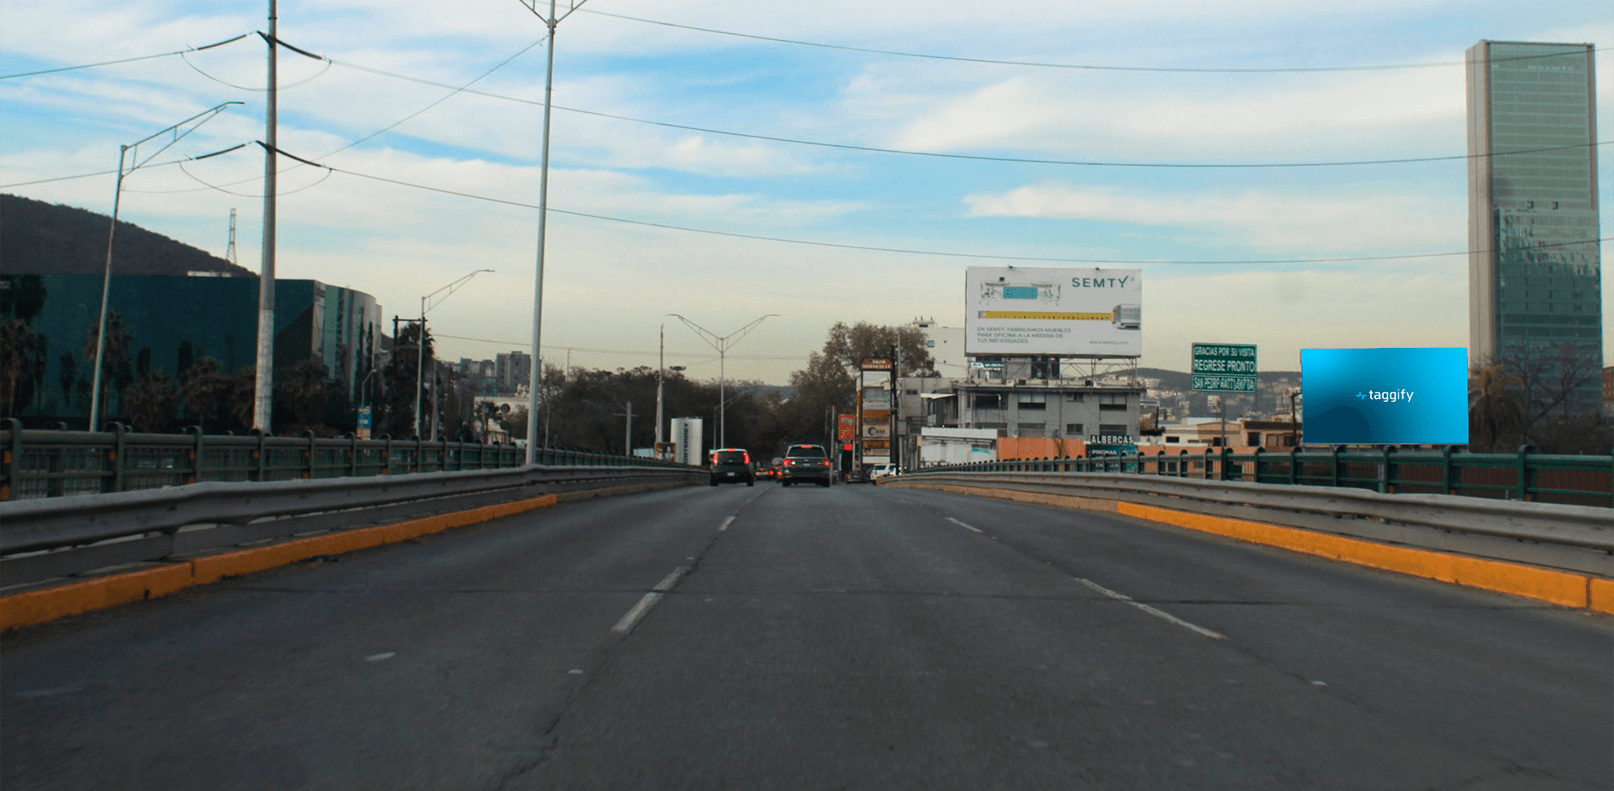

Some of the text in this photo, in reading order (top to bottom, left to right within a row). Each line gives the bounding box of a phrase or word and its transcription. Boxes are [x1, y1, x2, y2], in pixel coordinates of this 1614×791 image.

[1072, 276, 1128, 288] SEMTY
[1194, 346, 1218, 356] GRACIAS
[1219, 347, 1230, 356] POR
[1231, 348, 1238, 357] SU
[1194, 359, 1255, 372] REGRESE PRONTO
[1368, 388, 1414, 402] taggify
[1091, 435, 1134, 444] ALBERCAS
